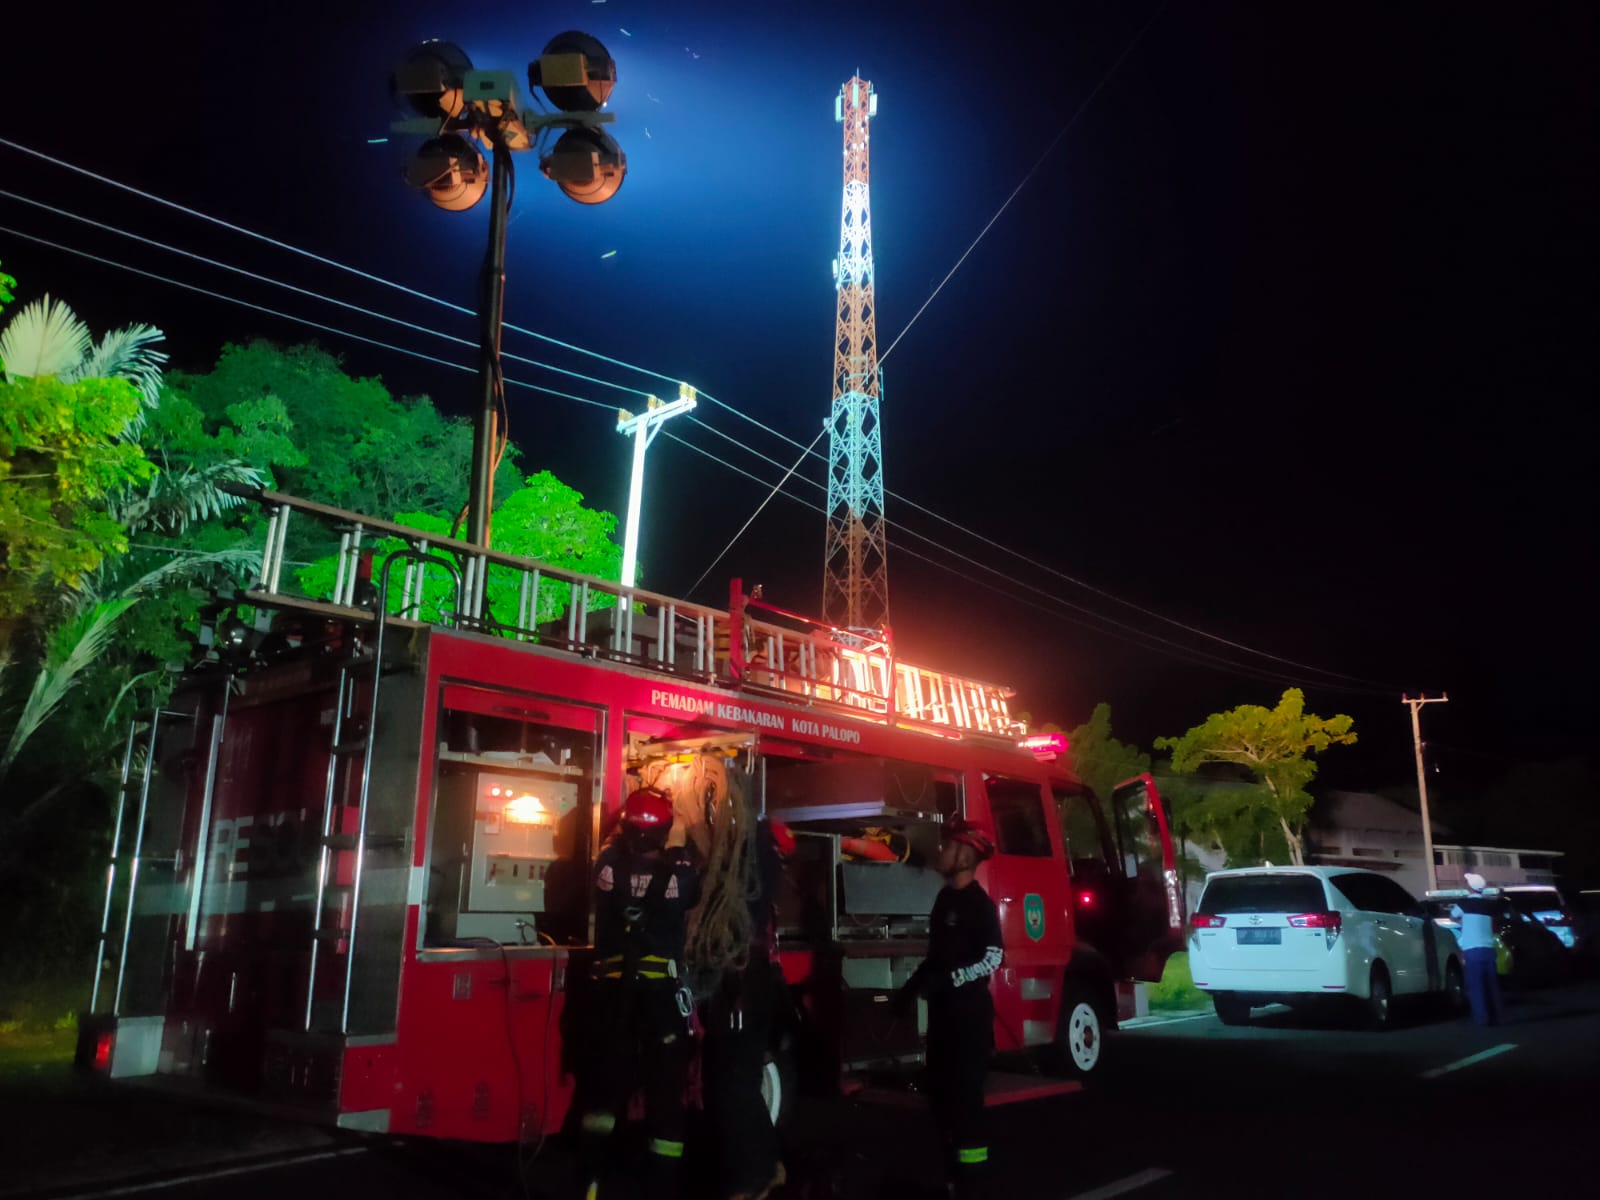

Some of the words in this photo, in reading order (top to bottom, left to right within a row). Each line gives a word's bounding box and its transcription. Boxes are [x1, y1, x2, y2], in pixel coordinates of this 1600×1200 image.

[651, 689, 714, 716] PEMADAM
[717, 703, 785, 730] KEBAKARAN
[792, 718, 819, 736] KOTA
[821, 724, 860, 744] PALOPO
